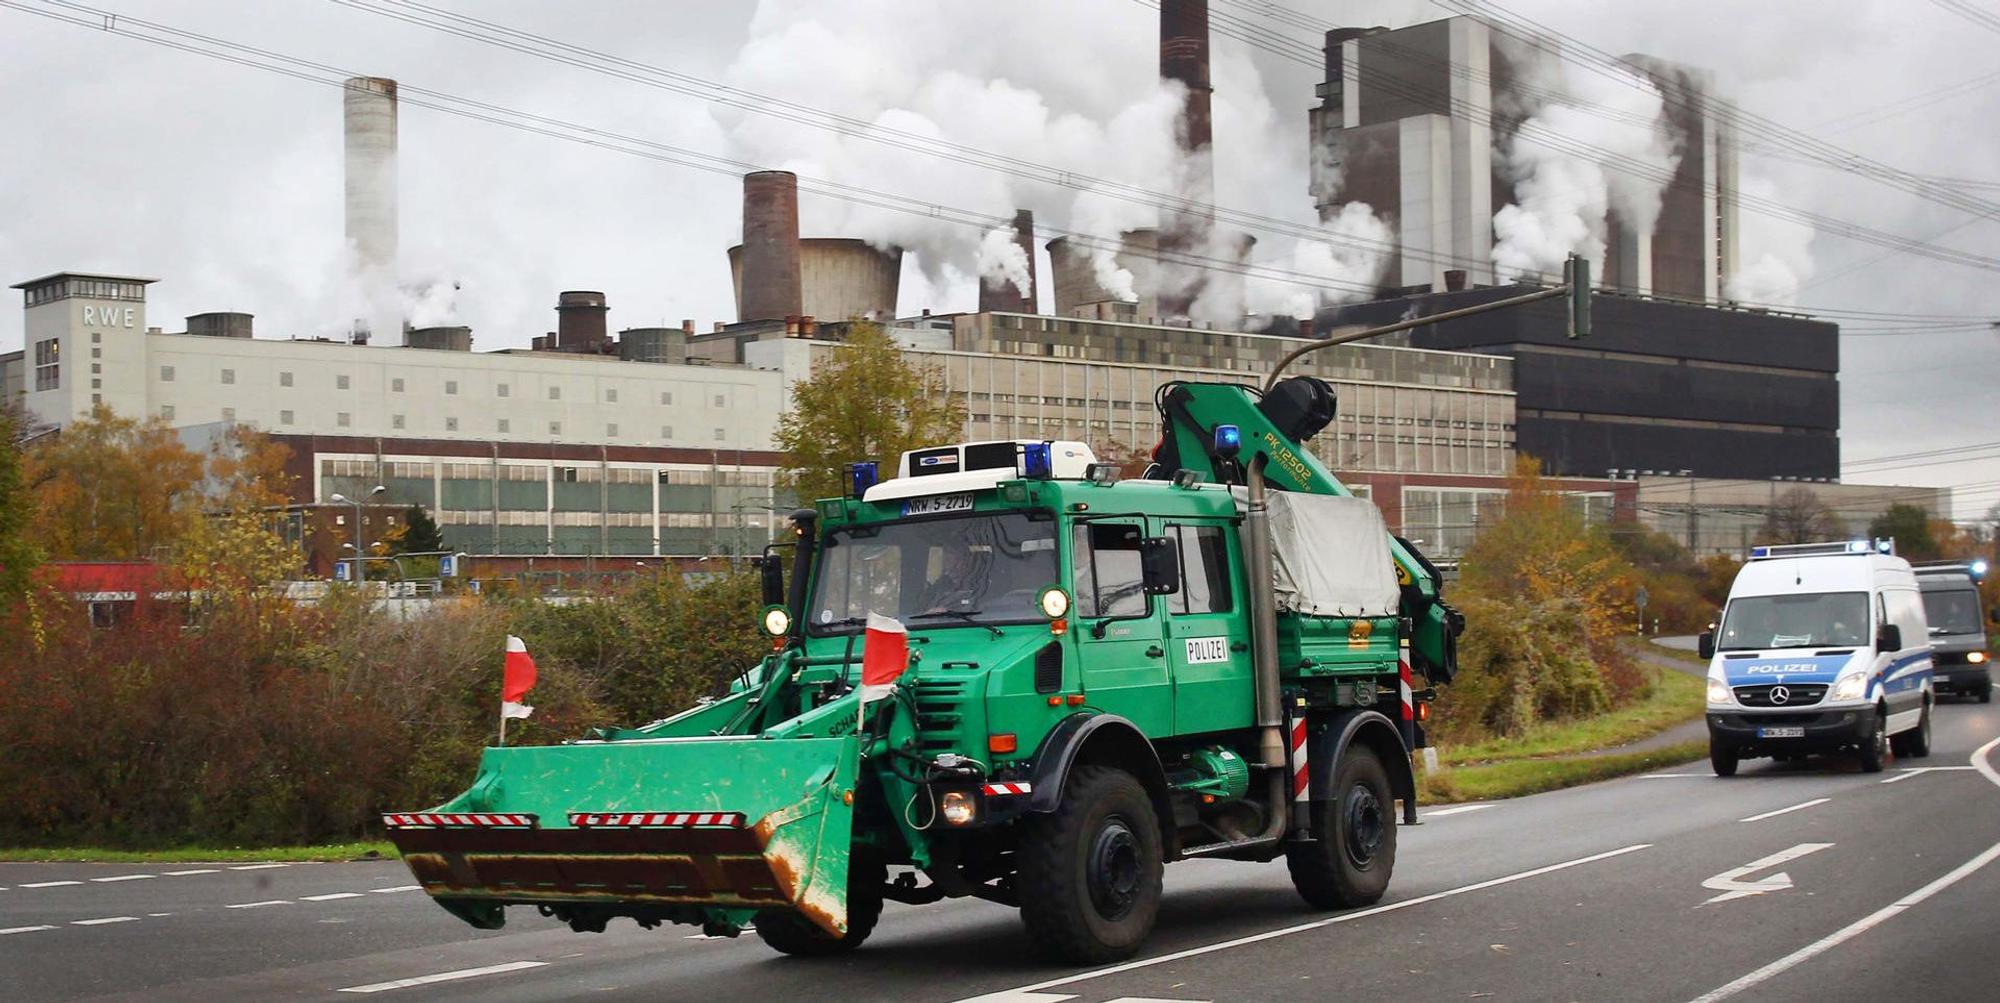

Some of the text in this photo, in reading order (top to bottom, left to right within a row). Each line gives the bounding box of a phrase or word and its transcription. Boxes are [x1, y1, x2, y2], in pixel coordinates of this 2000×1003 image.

[84, 305, 135, 328] RWE
[1264, 432, 1312, 480] PK 12502
[908, 494, 972, 513] NRW 5-2719
[1188, 640, 1226, 661] POLIZEI
[1747, 663, 1817, 675] POLIZEI
